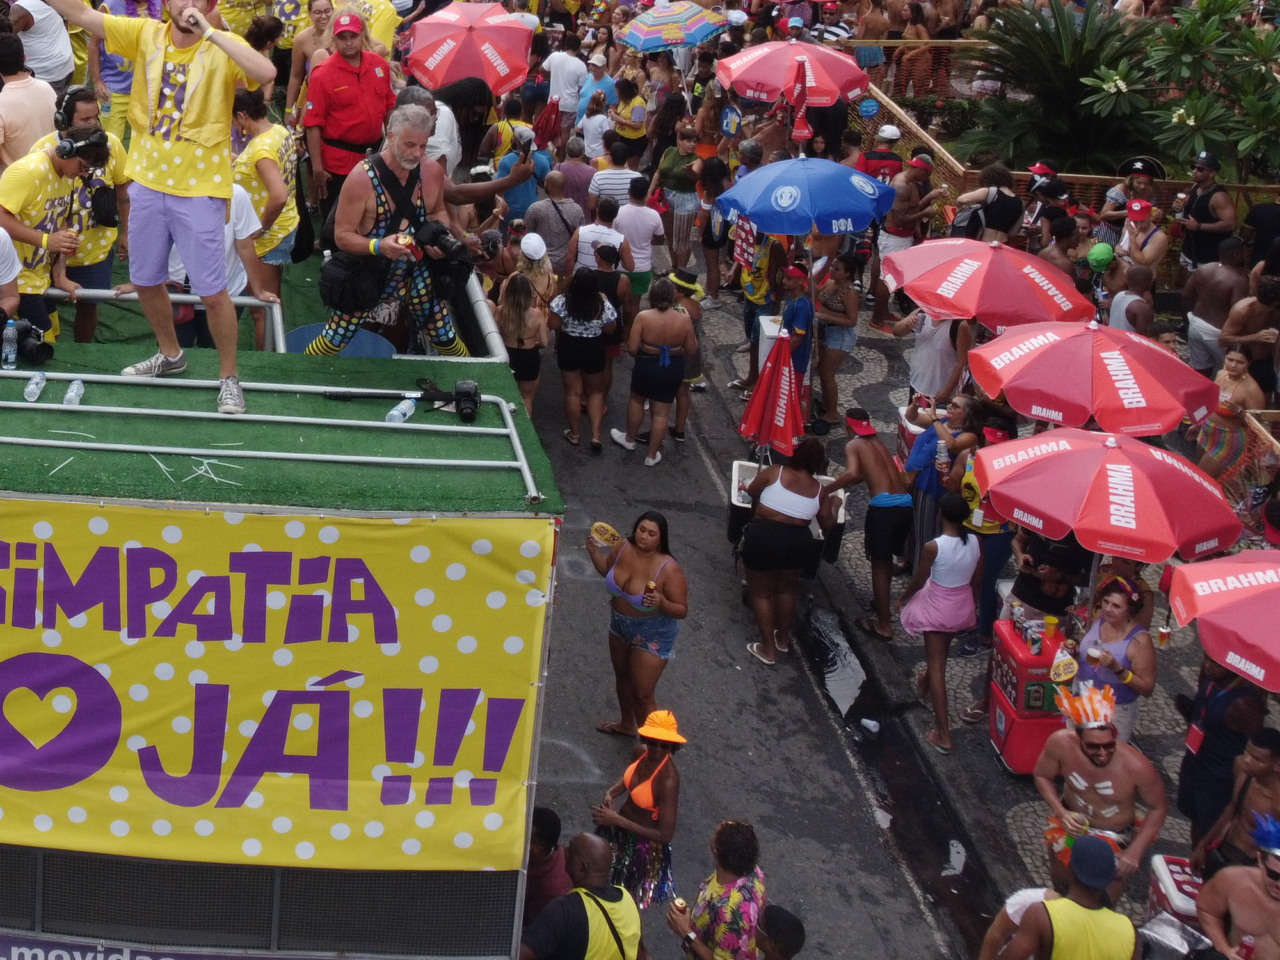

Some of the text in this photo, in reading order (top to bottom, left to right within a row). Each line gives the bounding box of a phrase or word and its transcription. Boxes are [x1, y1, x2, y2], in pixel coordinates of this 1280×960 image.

[424, 38, 456, 71] BRAHMA
[481, 42, 510, 77] BRAHMA
[936, 258, 982, 300] BRAHMA
[1022, 265, 1074, 312] BRAHMA
[989, 332, 1060, 371] BRAHMA
[1100, 350, 1148, 409] BRAHMA
[1031, 405, 1063, 422] BRAHMA
[992, 440, 1072, 471] BRAHMA
[1105, 463, 1137, 530] BRAHMA
[1012, 508, 1044, 531] BRAHMA
[1225, 651, 1266, 682] BRAHMA
